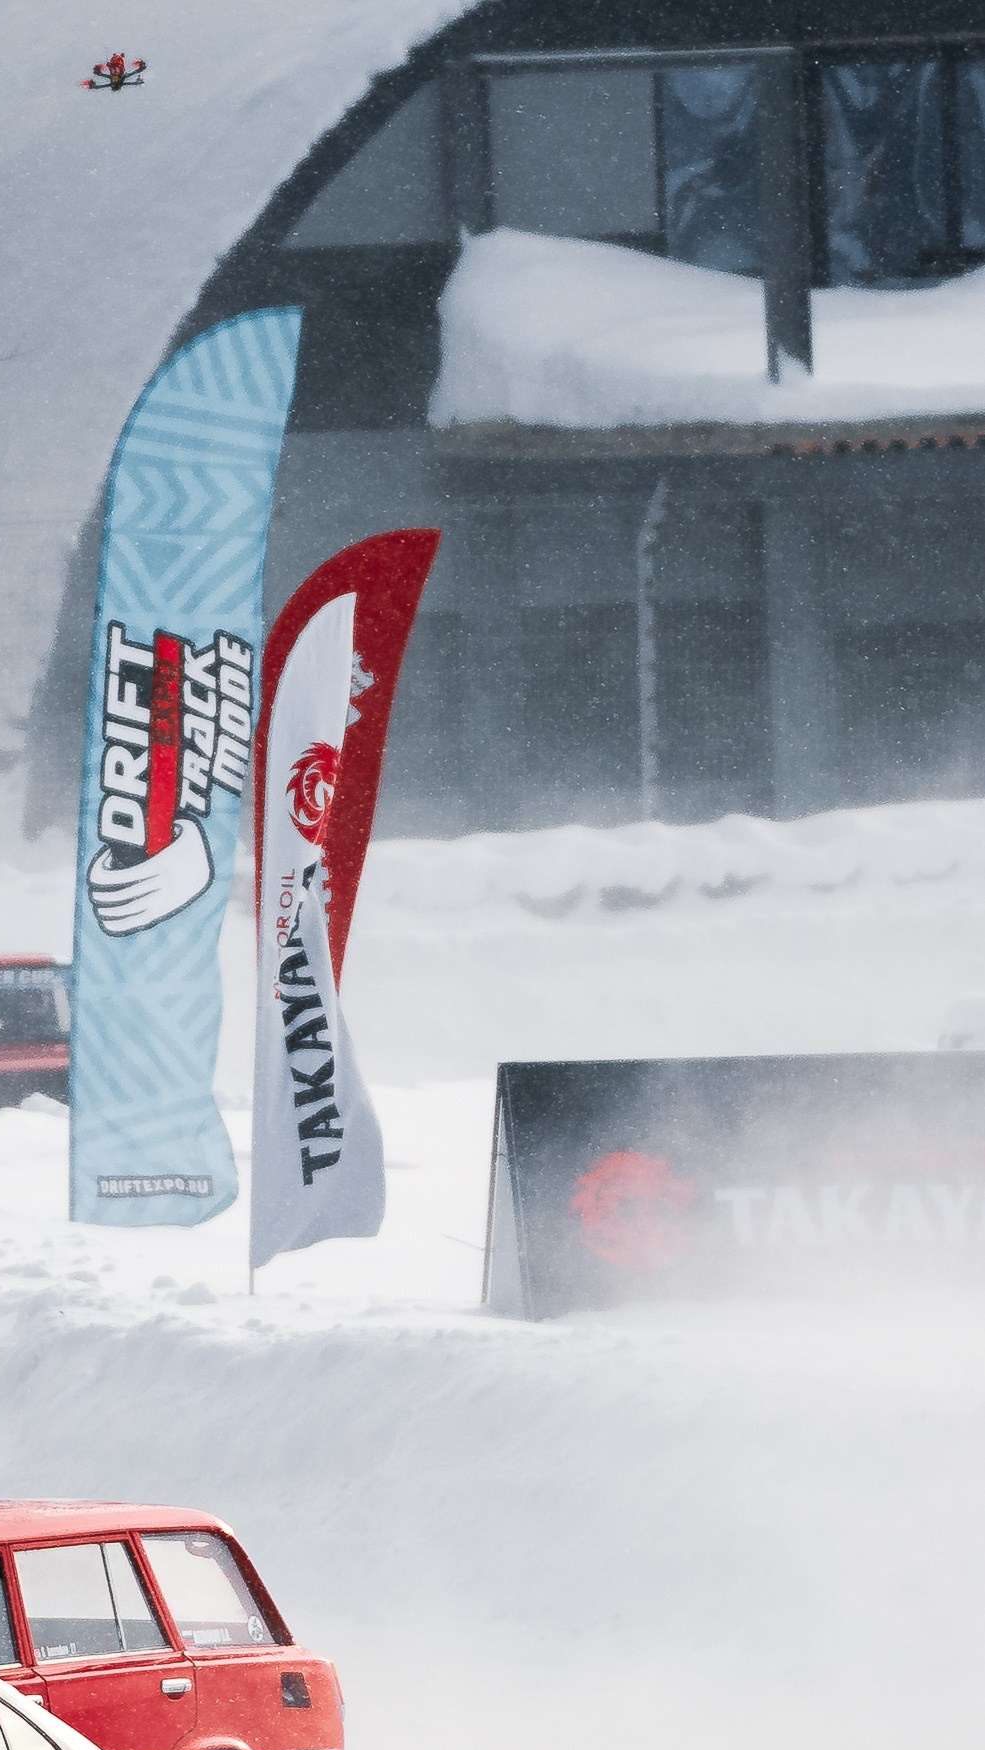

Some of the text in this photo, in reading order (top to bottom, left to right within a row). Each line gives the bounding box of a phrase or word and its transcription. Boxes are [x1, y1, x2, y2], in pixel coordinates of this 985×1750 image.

[100, 622, 155, 848] DRIFT
[280, 868, 297, 909] OIL
[99, 1177, 211, 1195] DRIFTEXPO.RU
[717, 1183, 985, 1246] TAKAY
